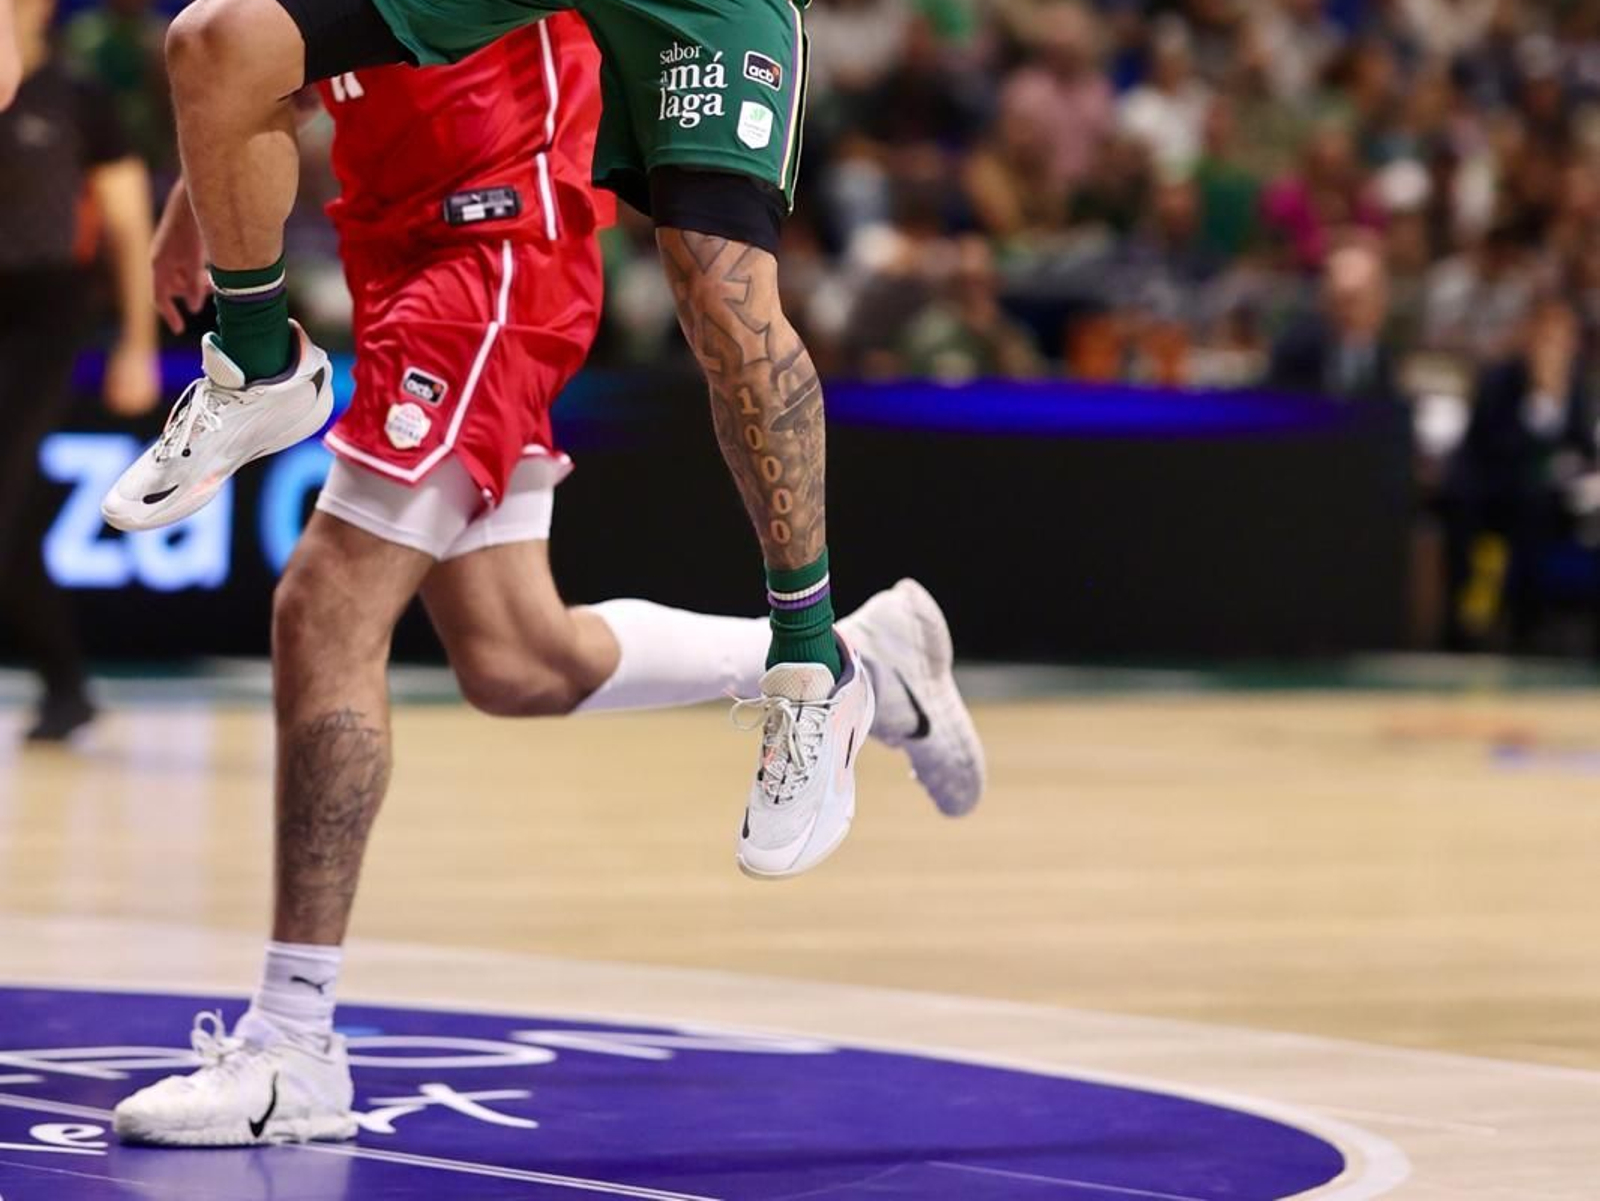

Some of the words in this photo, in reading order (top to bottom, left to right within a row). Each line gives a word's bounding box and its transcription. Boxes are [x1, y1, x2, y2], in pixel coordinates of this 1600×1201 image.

[659, 41, 702, 65] sabor
[748, 64, 776, 84] acb
[659, 87, 726, 129] laga
